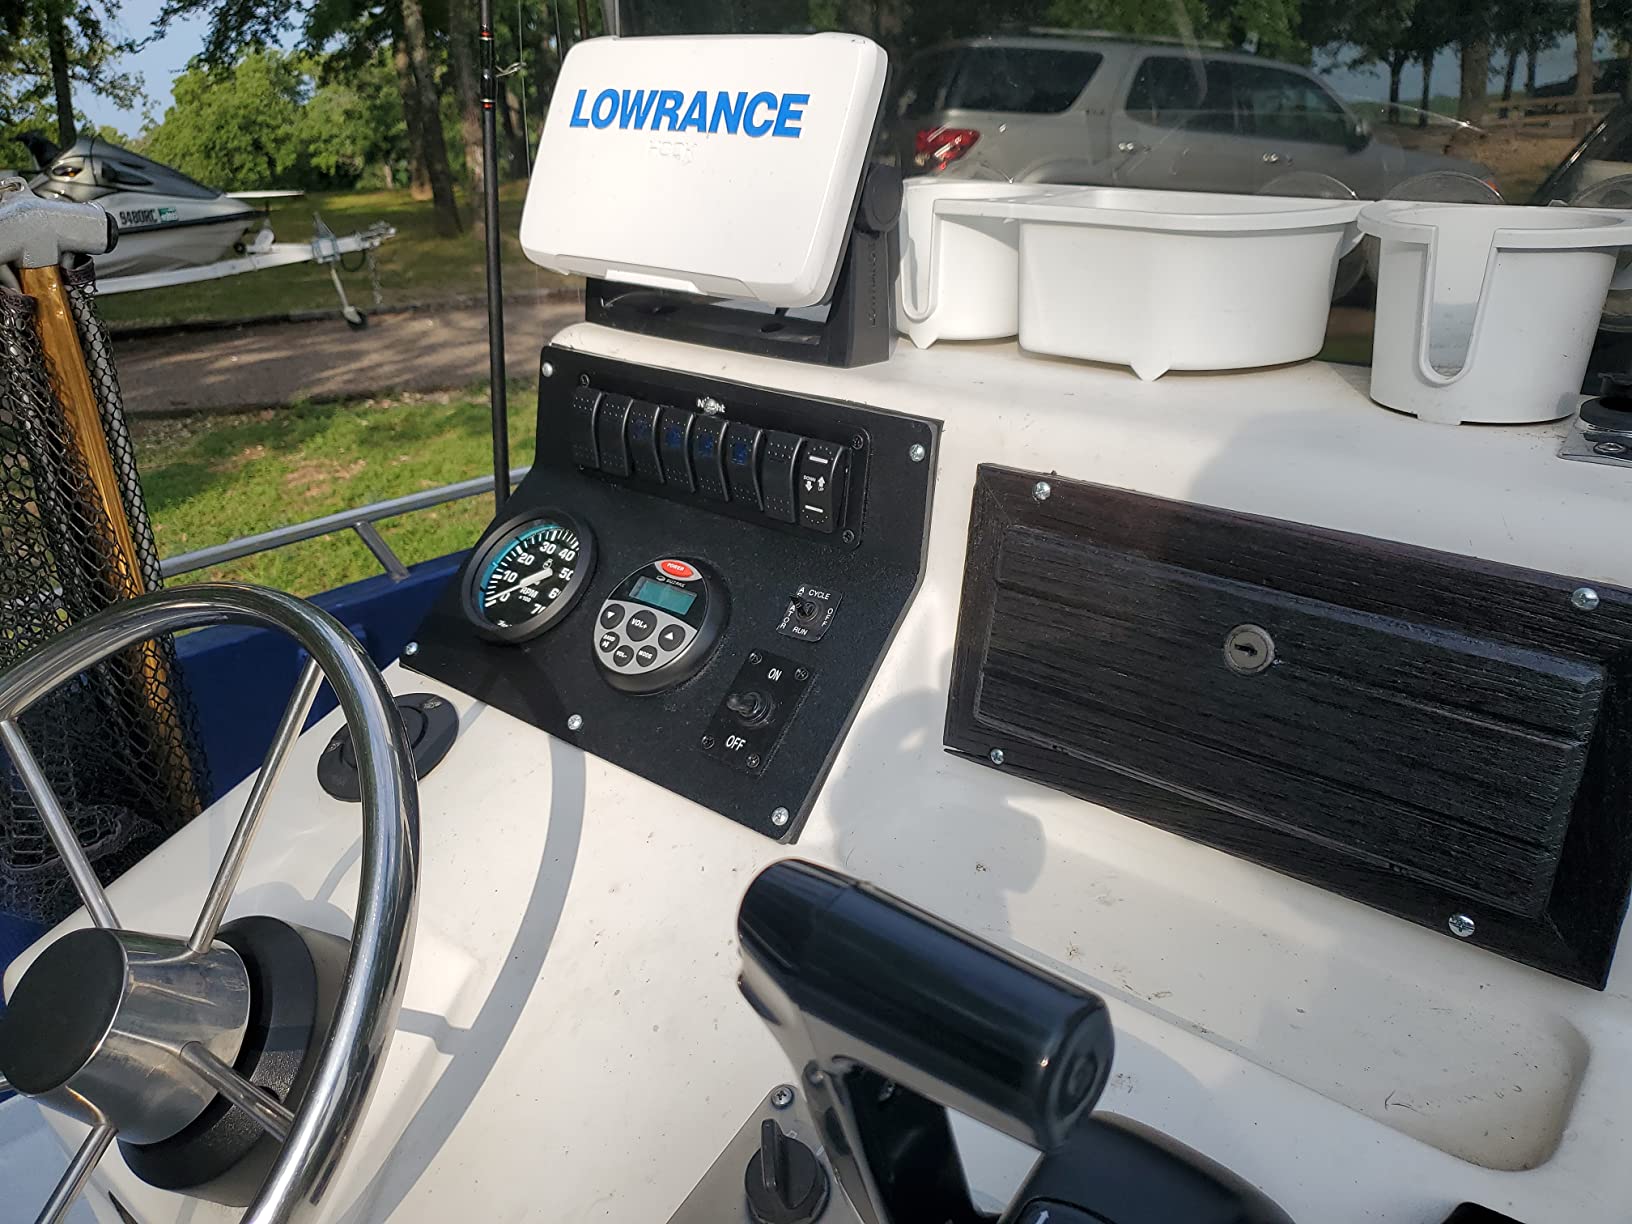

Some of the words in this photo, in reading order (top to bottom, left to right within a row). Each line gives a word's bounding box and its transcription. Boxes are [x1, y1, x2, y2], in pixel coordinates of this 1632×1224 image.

[569, 88, 810, 138] LOWRANCE
[539, 541, 557, 555] 30
[558, 548, 576, 562] 40
[517, 552, 535, 566] 20
[666, 562, 685, 572] POWER
[502, 569, 518, 583] 10
[520, 586, 539, 599] RPM
[548, 587, 561, 599] 6
[808, 589, 831, 600] CYCLE
[780, 586, 805, 630] AEATOR
[631, 618, 648, 629] VOL+
[821, 607, 834, 627] OFF
[792, 626, 809, 636] RUN
[767, 667, 783, 681] ON
[725, 734, 746, 751] OFF
